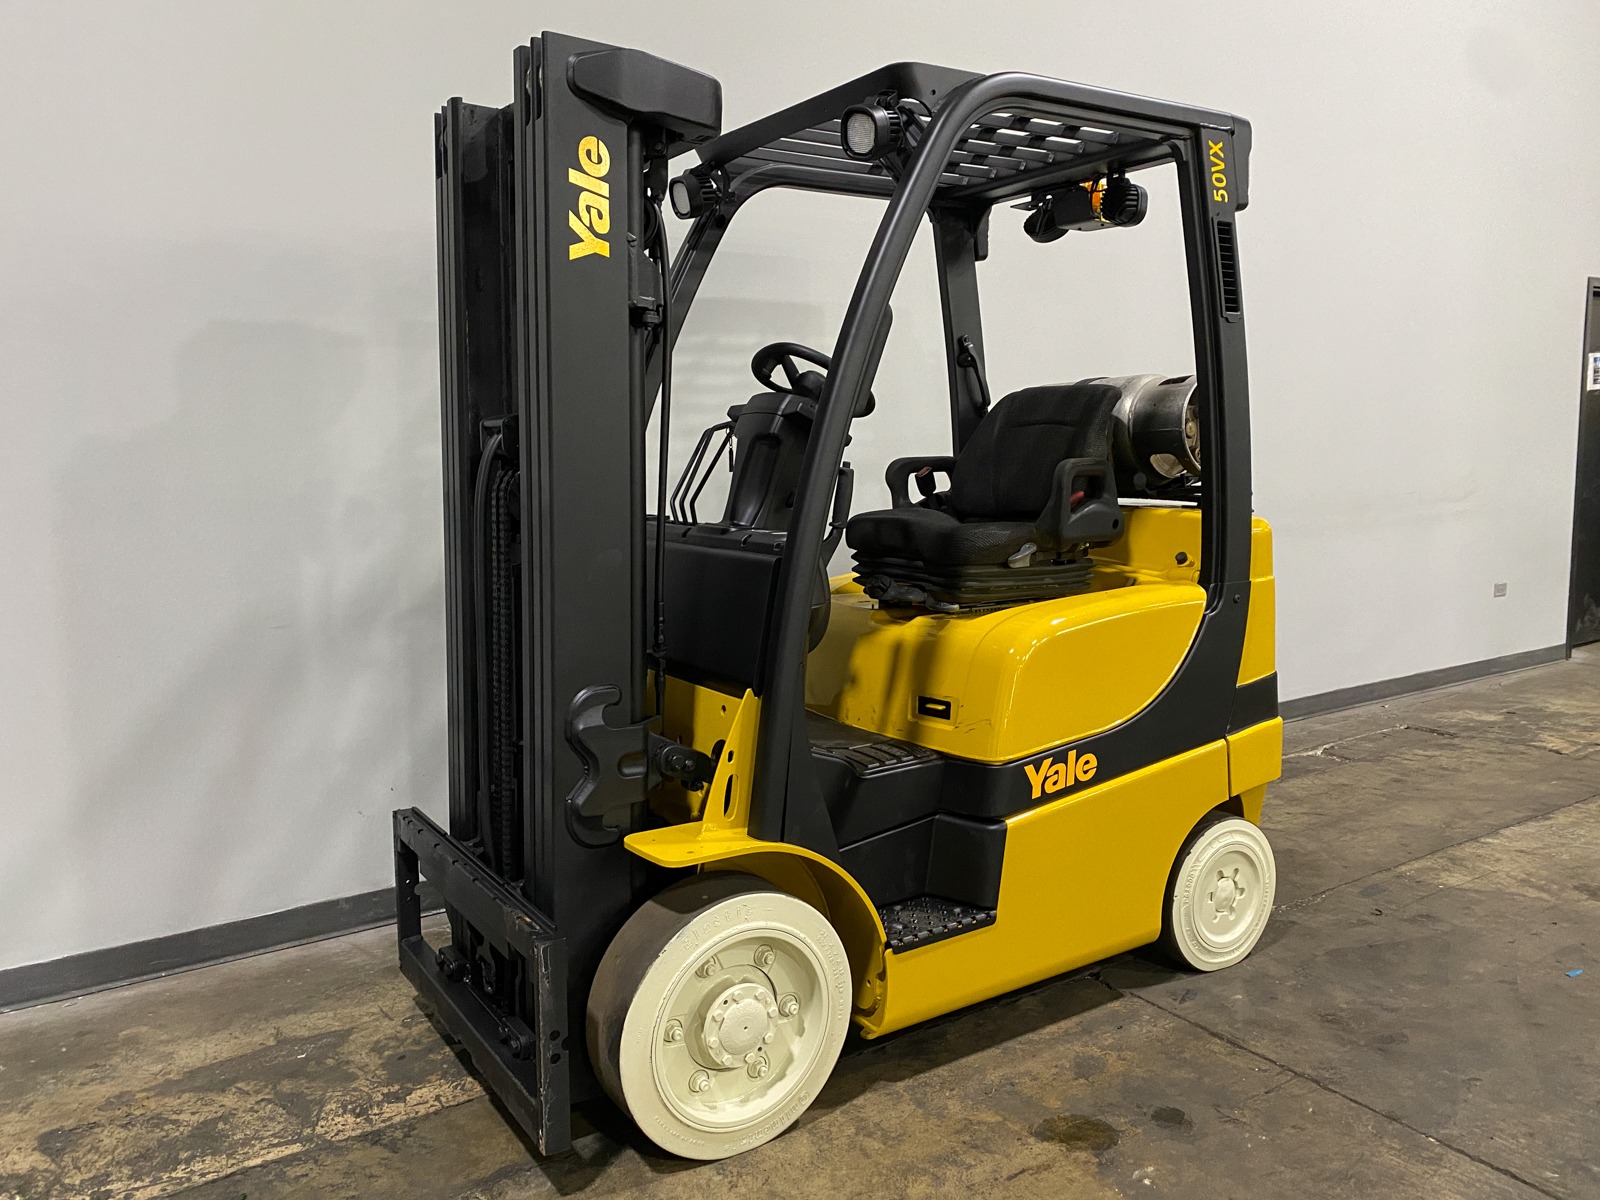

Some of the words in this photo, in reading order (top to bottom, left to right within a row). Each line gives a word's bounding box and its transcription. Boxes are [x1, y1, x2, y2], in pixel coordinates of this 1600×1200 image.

[568, 135, 610, 260] Yale
[1208, 139, 1229, 203] 50VX
[1023, 749, 1098, 800] Yale
